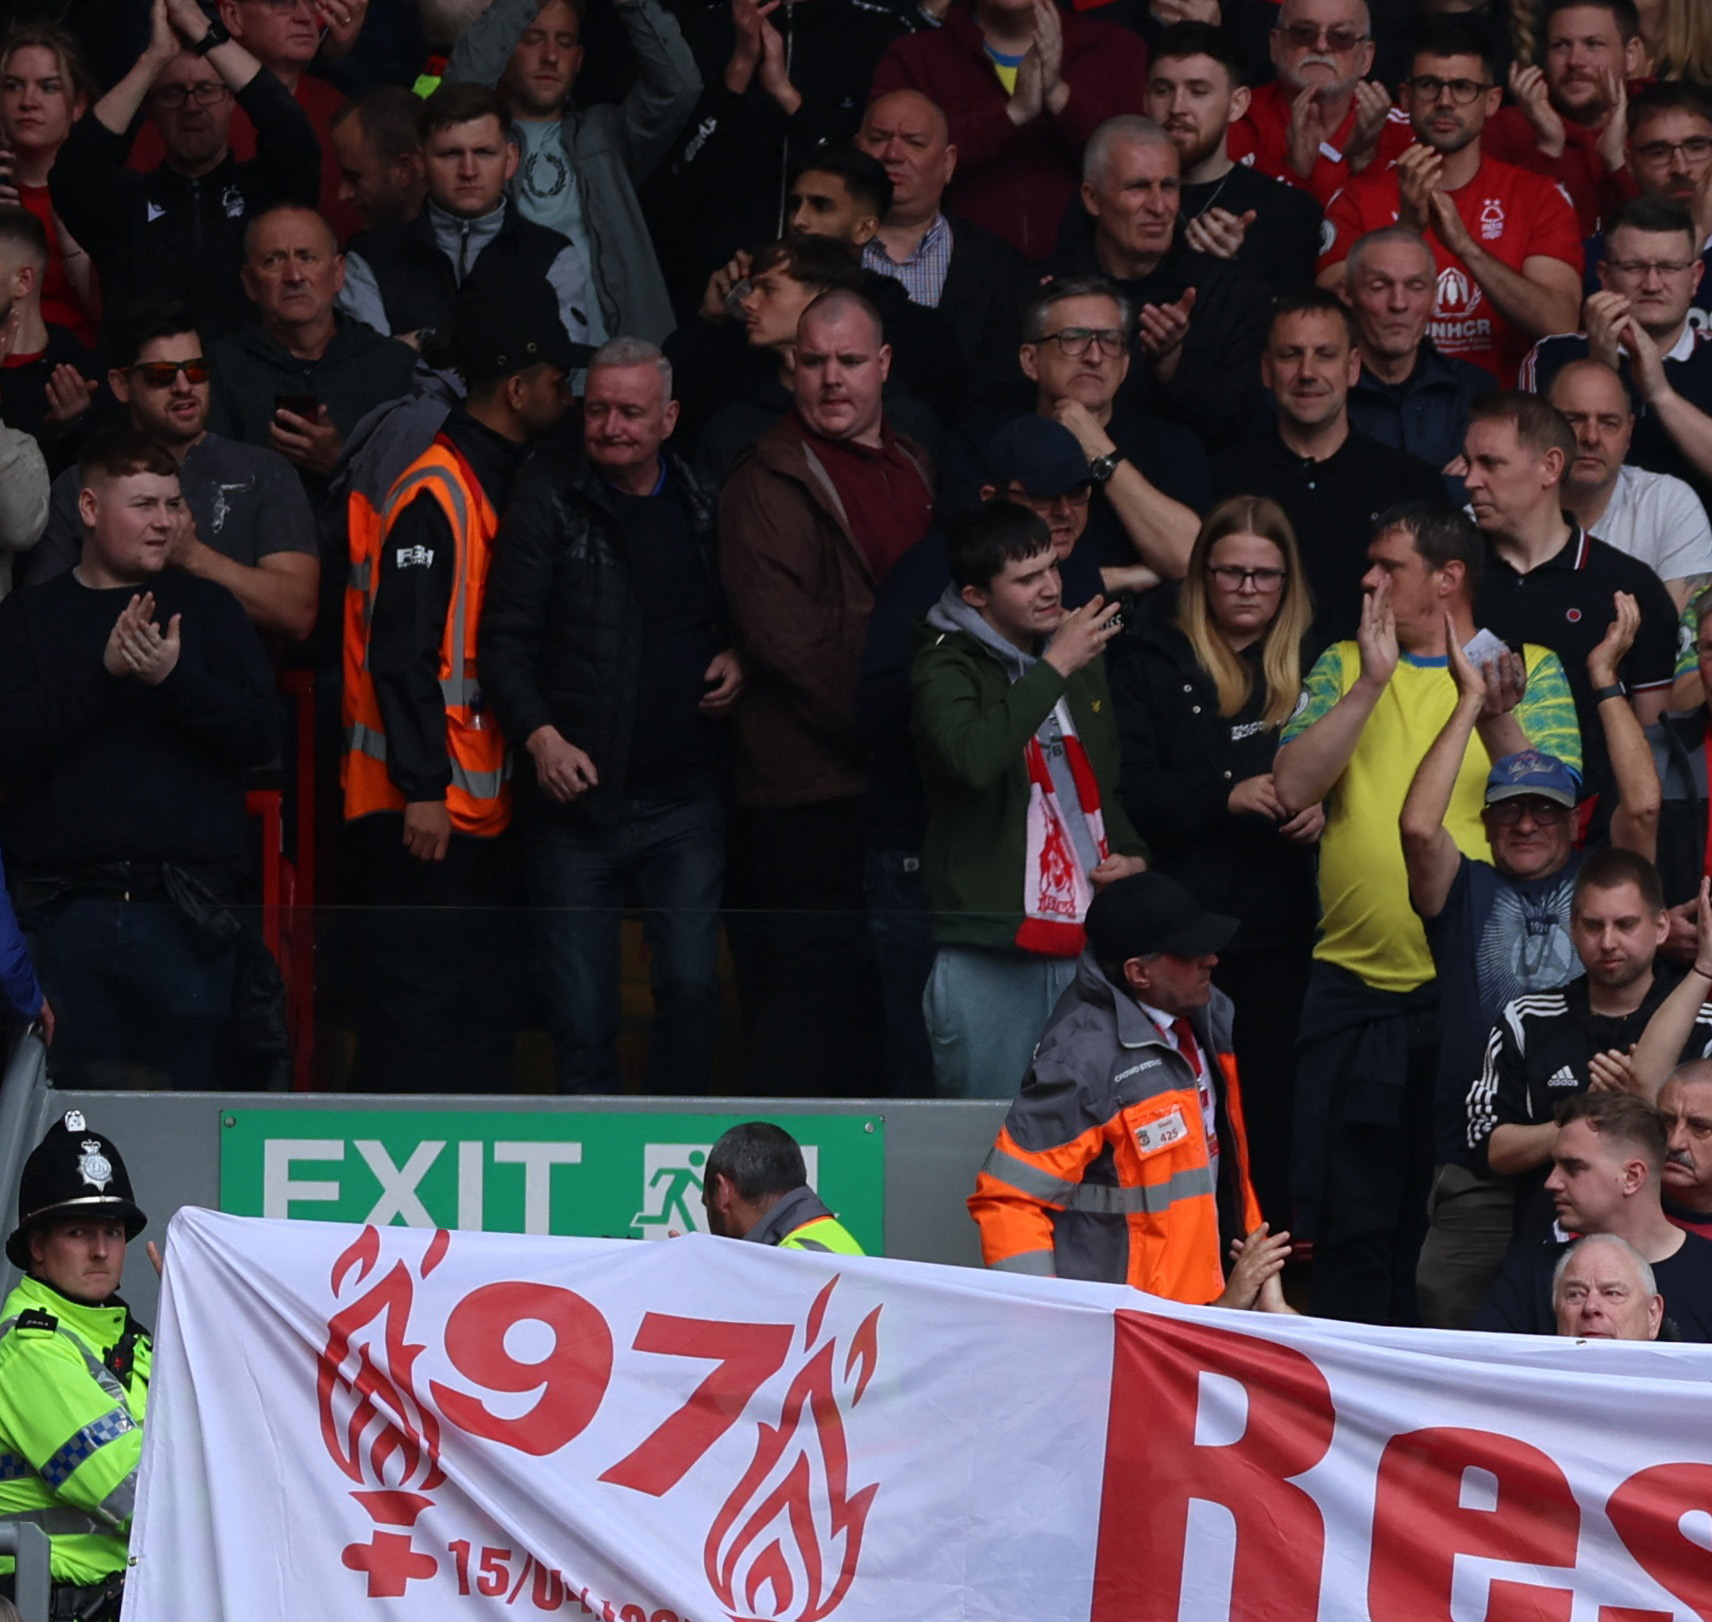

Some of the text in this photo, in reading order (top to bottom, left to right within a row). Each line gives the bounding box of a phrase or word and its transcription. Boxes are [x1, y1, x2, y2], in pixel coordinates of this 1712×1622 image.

[1160, 1128, 1179, 1142] 425
[263, 1138, 582, 1235] EXIT
[430, 1282, 795, 1497] 97
